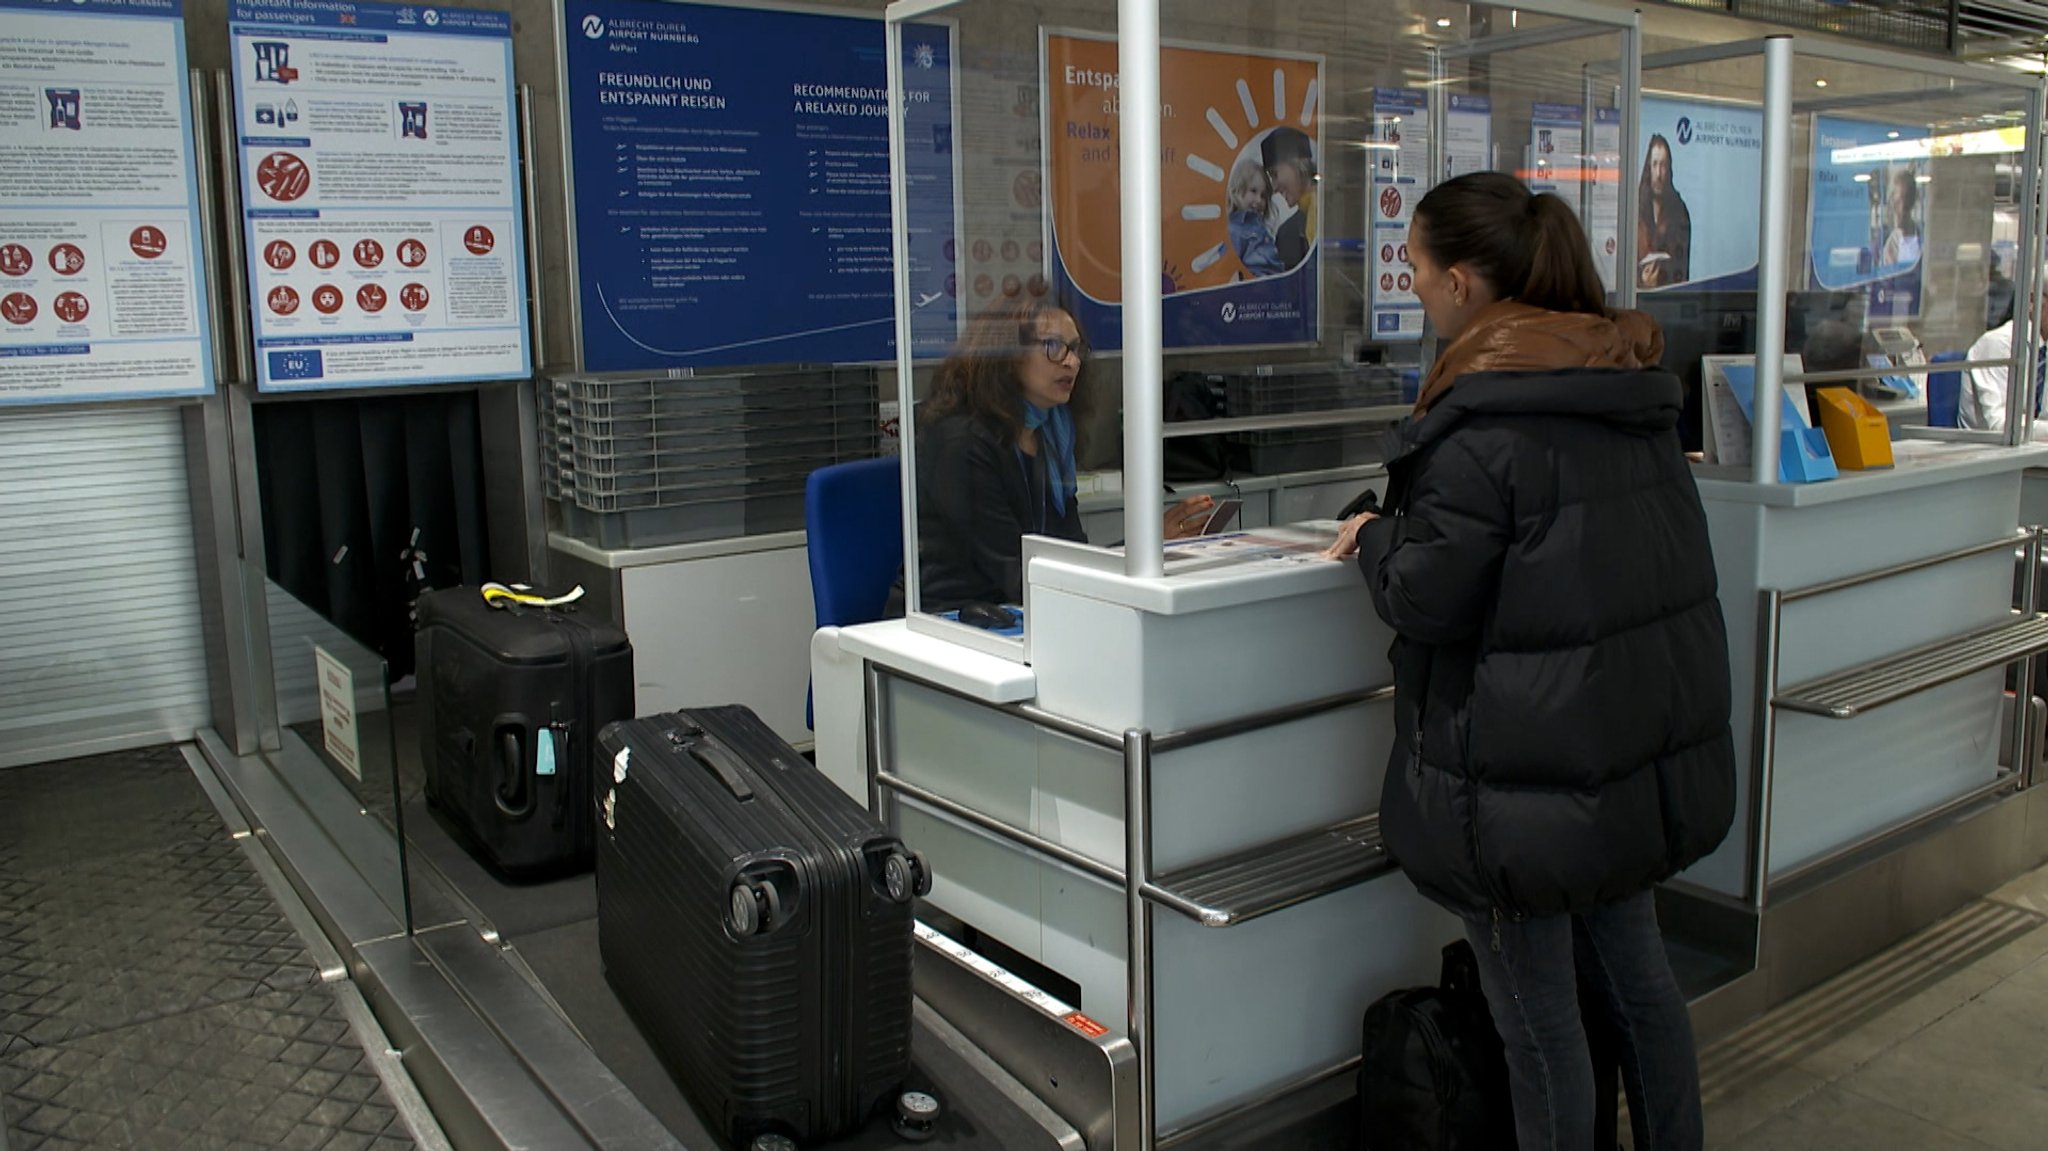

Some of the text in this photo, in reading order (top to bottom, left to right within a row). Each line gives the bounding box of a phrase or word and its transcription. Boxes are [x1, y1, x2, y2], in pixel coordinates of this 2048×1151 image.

[237, 8, 315, 24] for passengers
[608, 19, 654, 31] ALBRECHT
[608, 29, 648, 40] AIRPORT
[599, 72, 712, 91] FREUNDLICH UND
[1065, 65, 1120, 92] Entspa
[600, 91, 726, 110] ENTSPANNT REISEN
[909, 91, 930, 103] FOR
[794, 102, 804, 114] A
[805, 102, 858, 117] RELAXED
[1067, 121, 1110, 140] Relax
[1694, 134, 1724, 146] AIRPORT
[1082, 145, 1110, 161] and
[287, 360, 304, 370] EU
